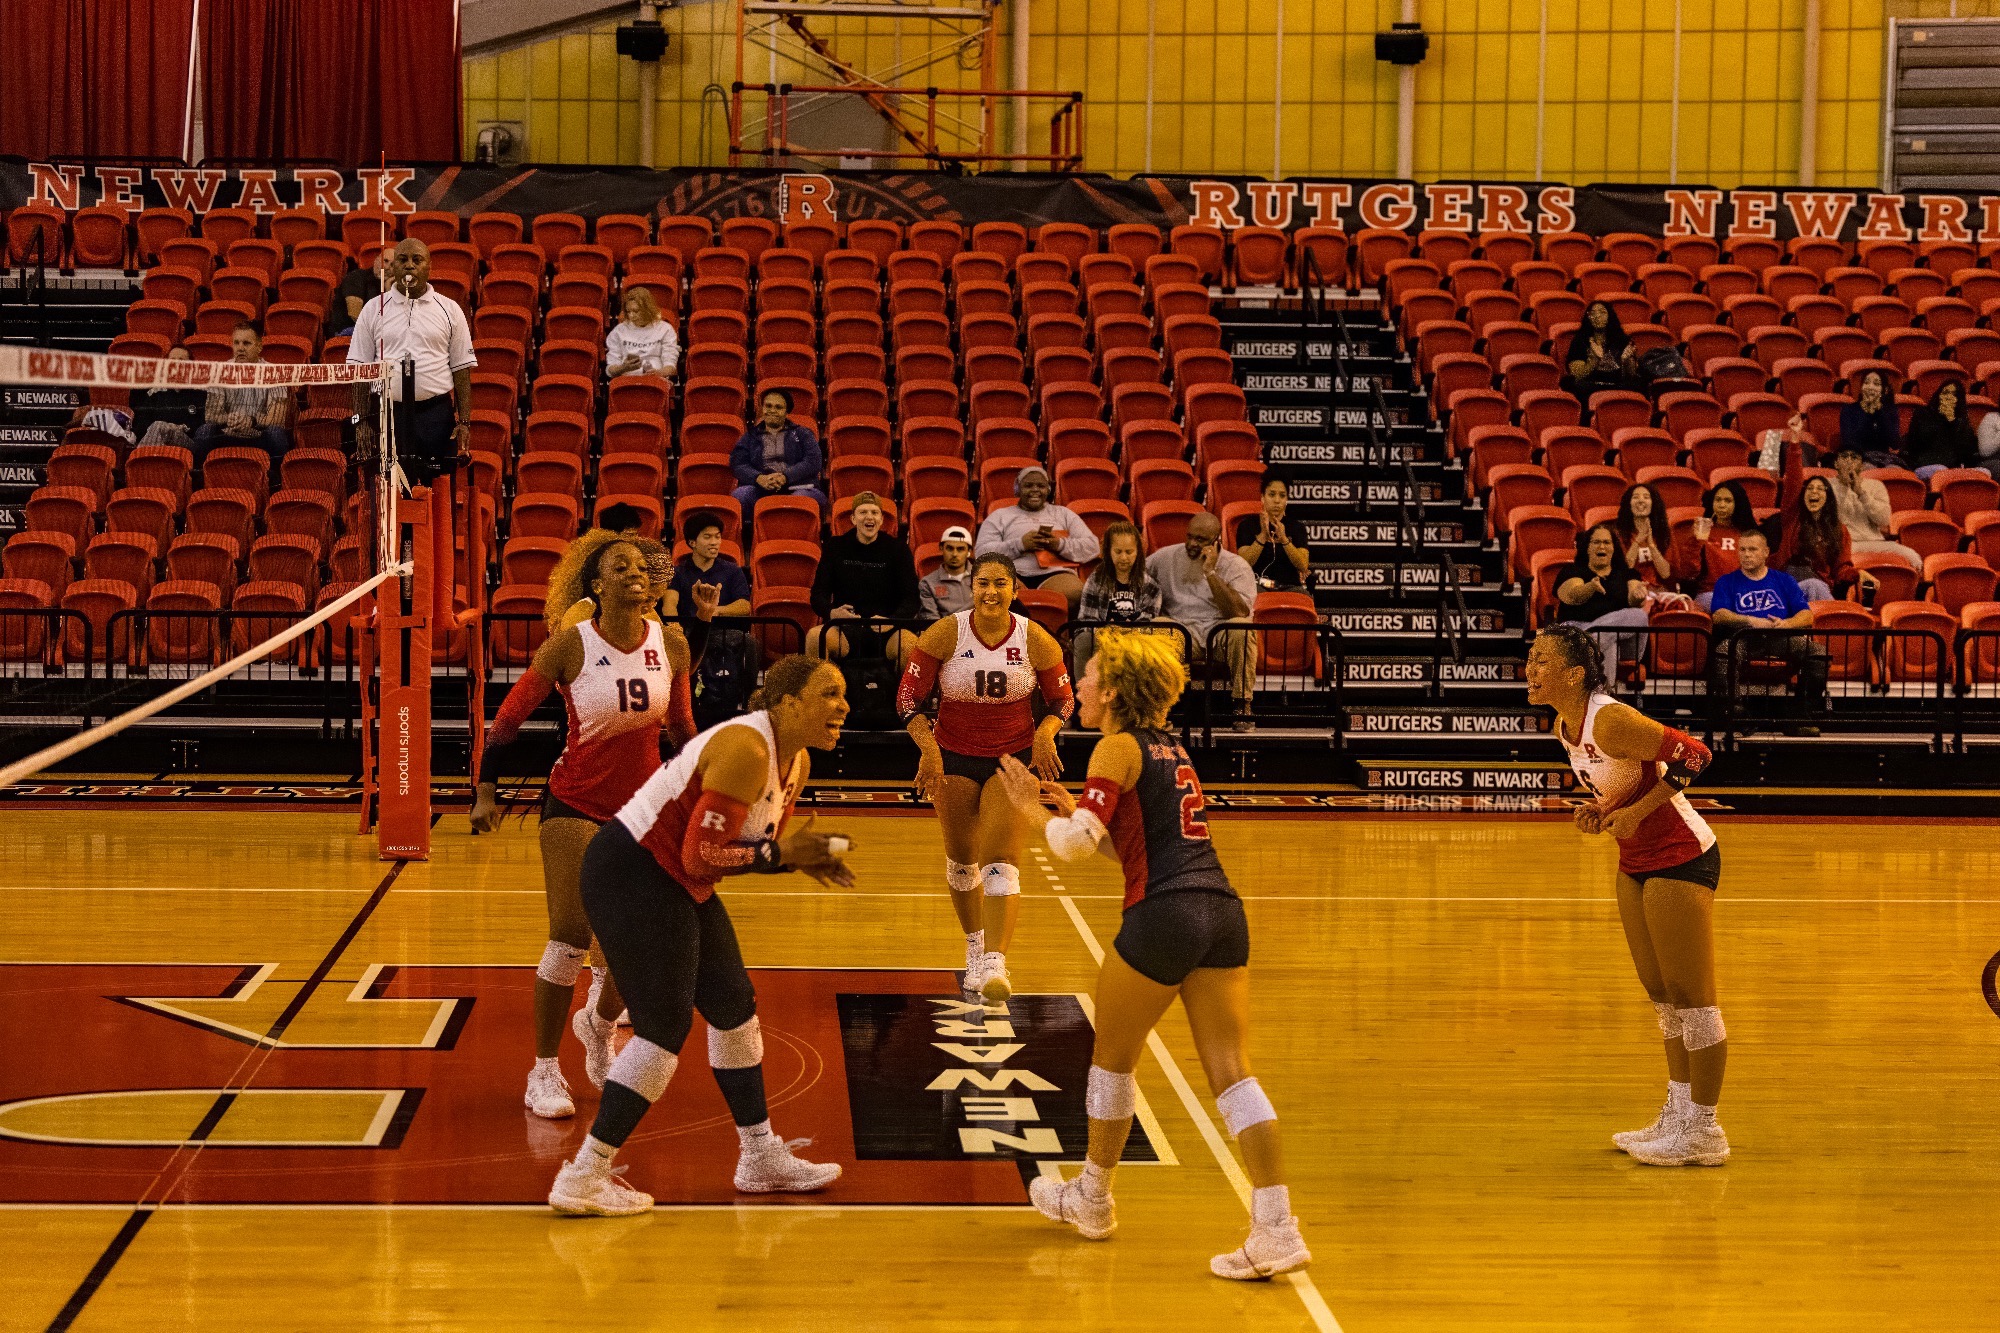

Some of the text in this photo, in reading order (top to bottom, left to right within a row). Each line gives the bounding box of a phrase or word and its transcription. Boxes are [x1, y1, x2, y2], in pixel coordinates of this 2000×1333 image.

[27, 163, 417, 215] NEWARK
[779, 173, 838, 225] R
[1188, 181, 1576, 234] RUTGERS
[1236, 342, 1297, 356] RUTGERS
[1246, 375, 1308, 389] RUTGERS
[17, 392, 68, 404] NEWARK
[1258, 409, 1323, 424] RUTGERS
[1270, 445, 1335, 460] RUTGERS
[1721, 537, 1736, 551] R
[1315, 569, 1385, 584] RUTGERS
[1331, 614, 1404, 631] RUTGERS
[644, 649, 662, 666] R
[1006, 647, 1024, 661] R
[1348, 663, 1423, 680] RUTGERS
[974, 669, 1008, 698] 18
[616, 677, 650, 713] 19
[398, 706, 410, 746] sports
[1366, 715, 1443, 732] RUTGERS
[1452, 716, 1522, 732] NEWARK
[1384, 769, 1463, 788] RUTGERS
[1473, 771, 1544, 789] NEWARK
[701, 810, 727, 832] R
[924, 999, 1064, 1154] NEWARK
